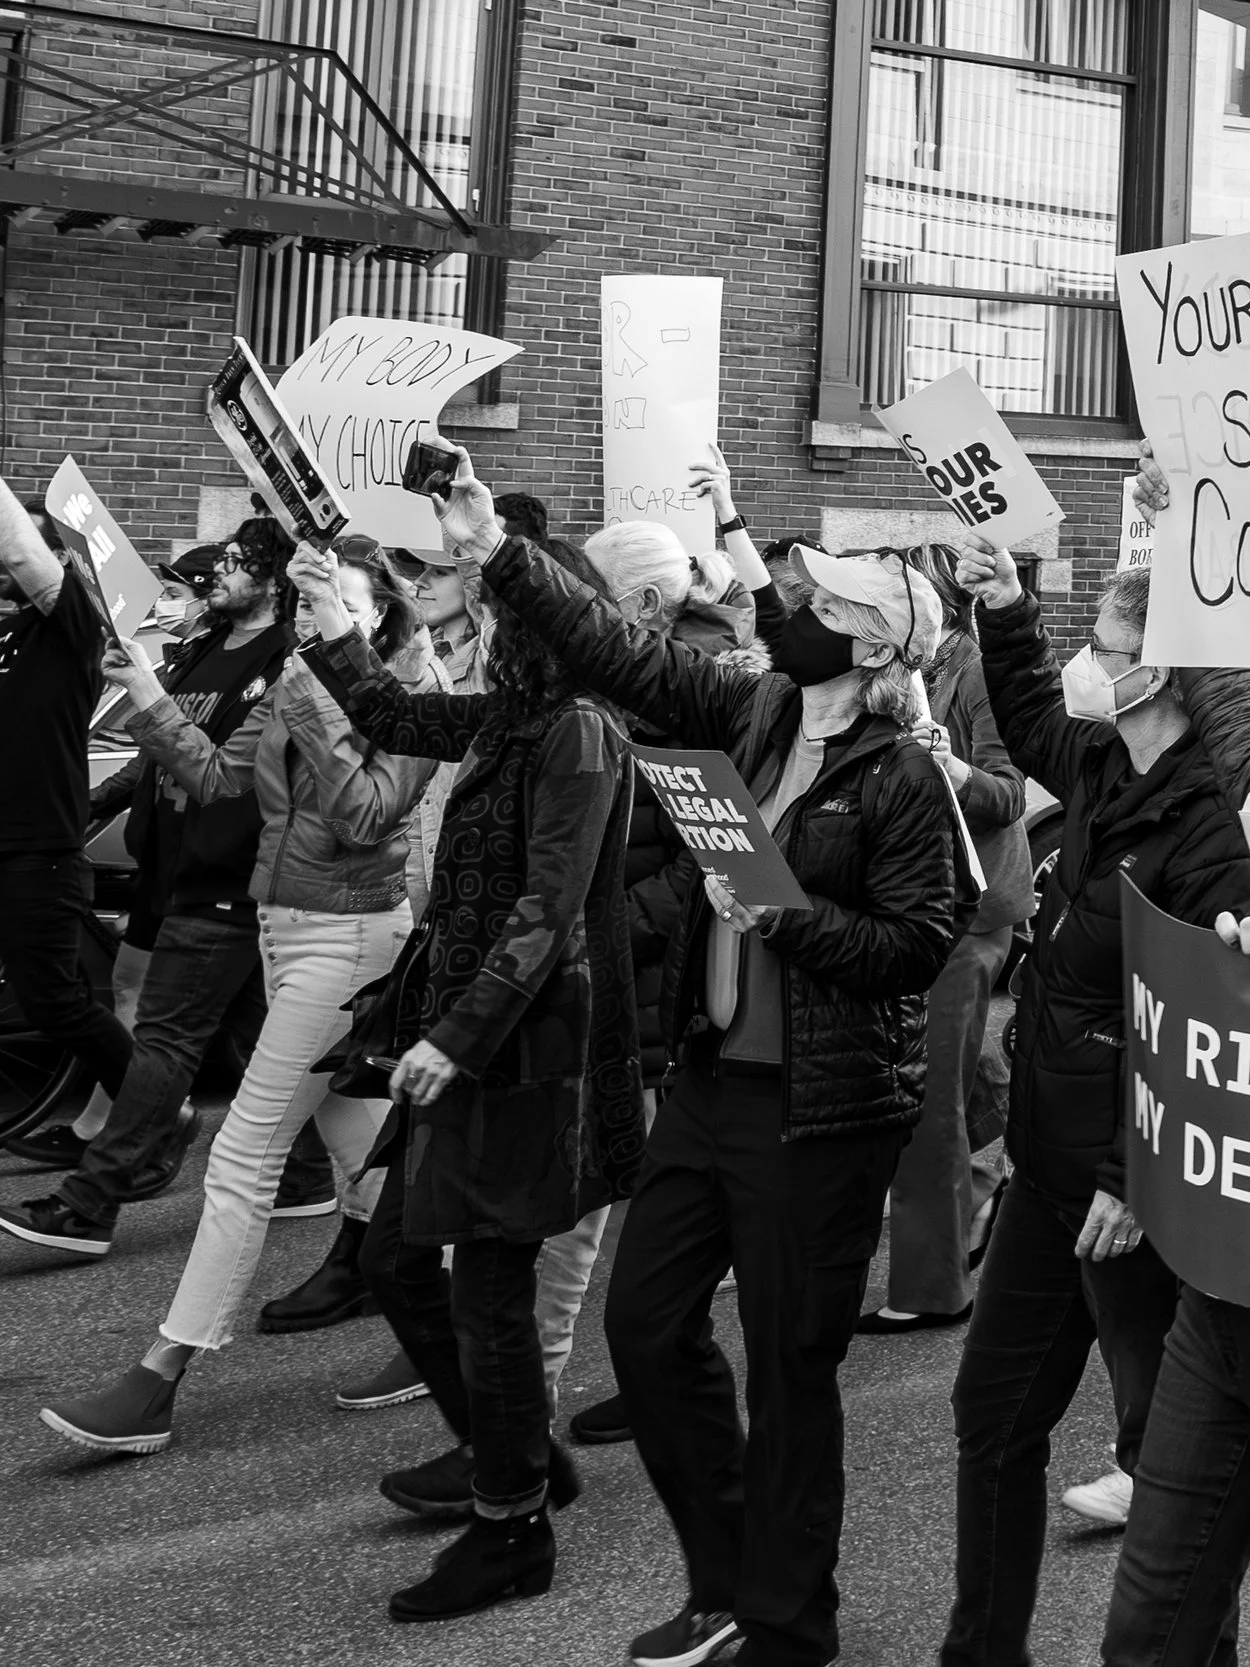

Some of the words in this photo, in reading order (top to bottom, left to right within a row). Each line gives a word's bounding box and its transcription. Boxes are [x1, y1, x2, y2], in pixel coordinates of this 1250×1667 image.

[298, 334, 383, 382] MY
[366, 336, 496, 390] BODY
[926, 442, 1003, 497] OUR
[666, 794, 749, 823] LEGAL
[1132, 973, 1166, 1056] MY
[1133, 1071, 1166, 1155] MY
